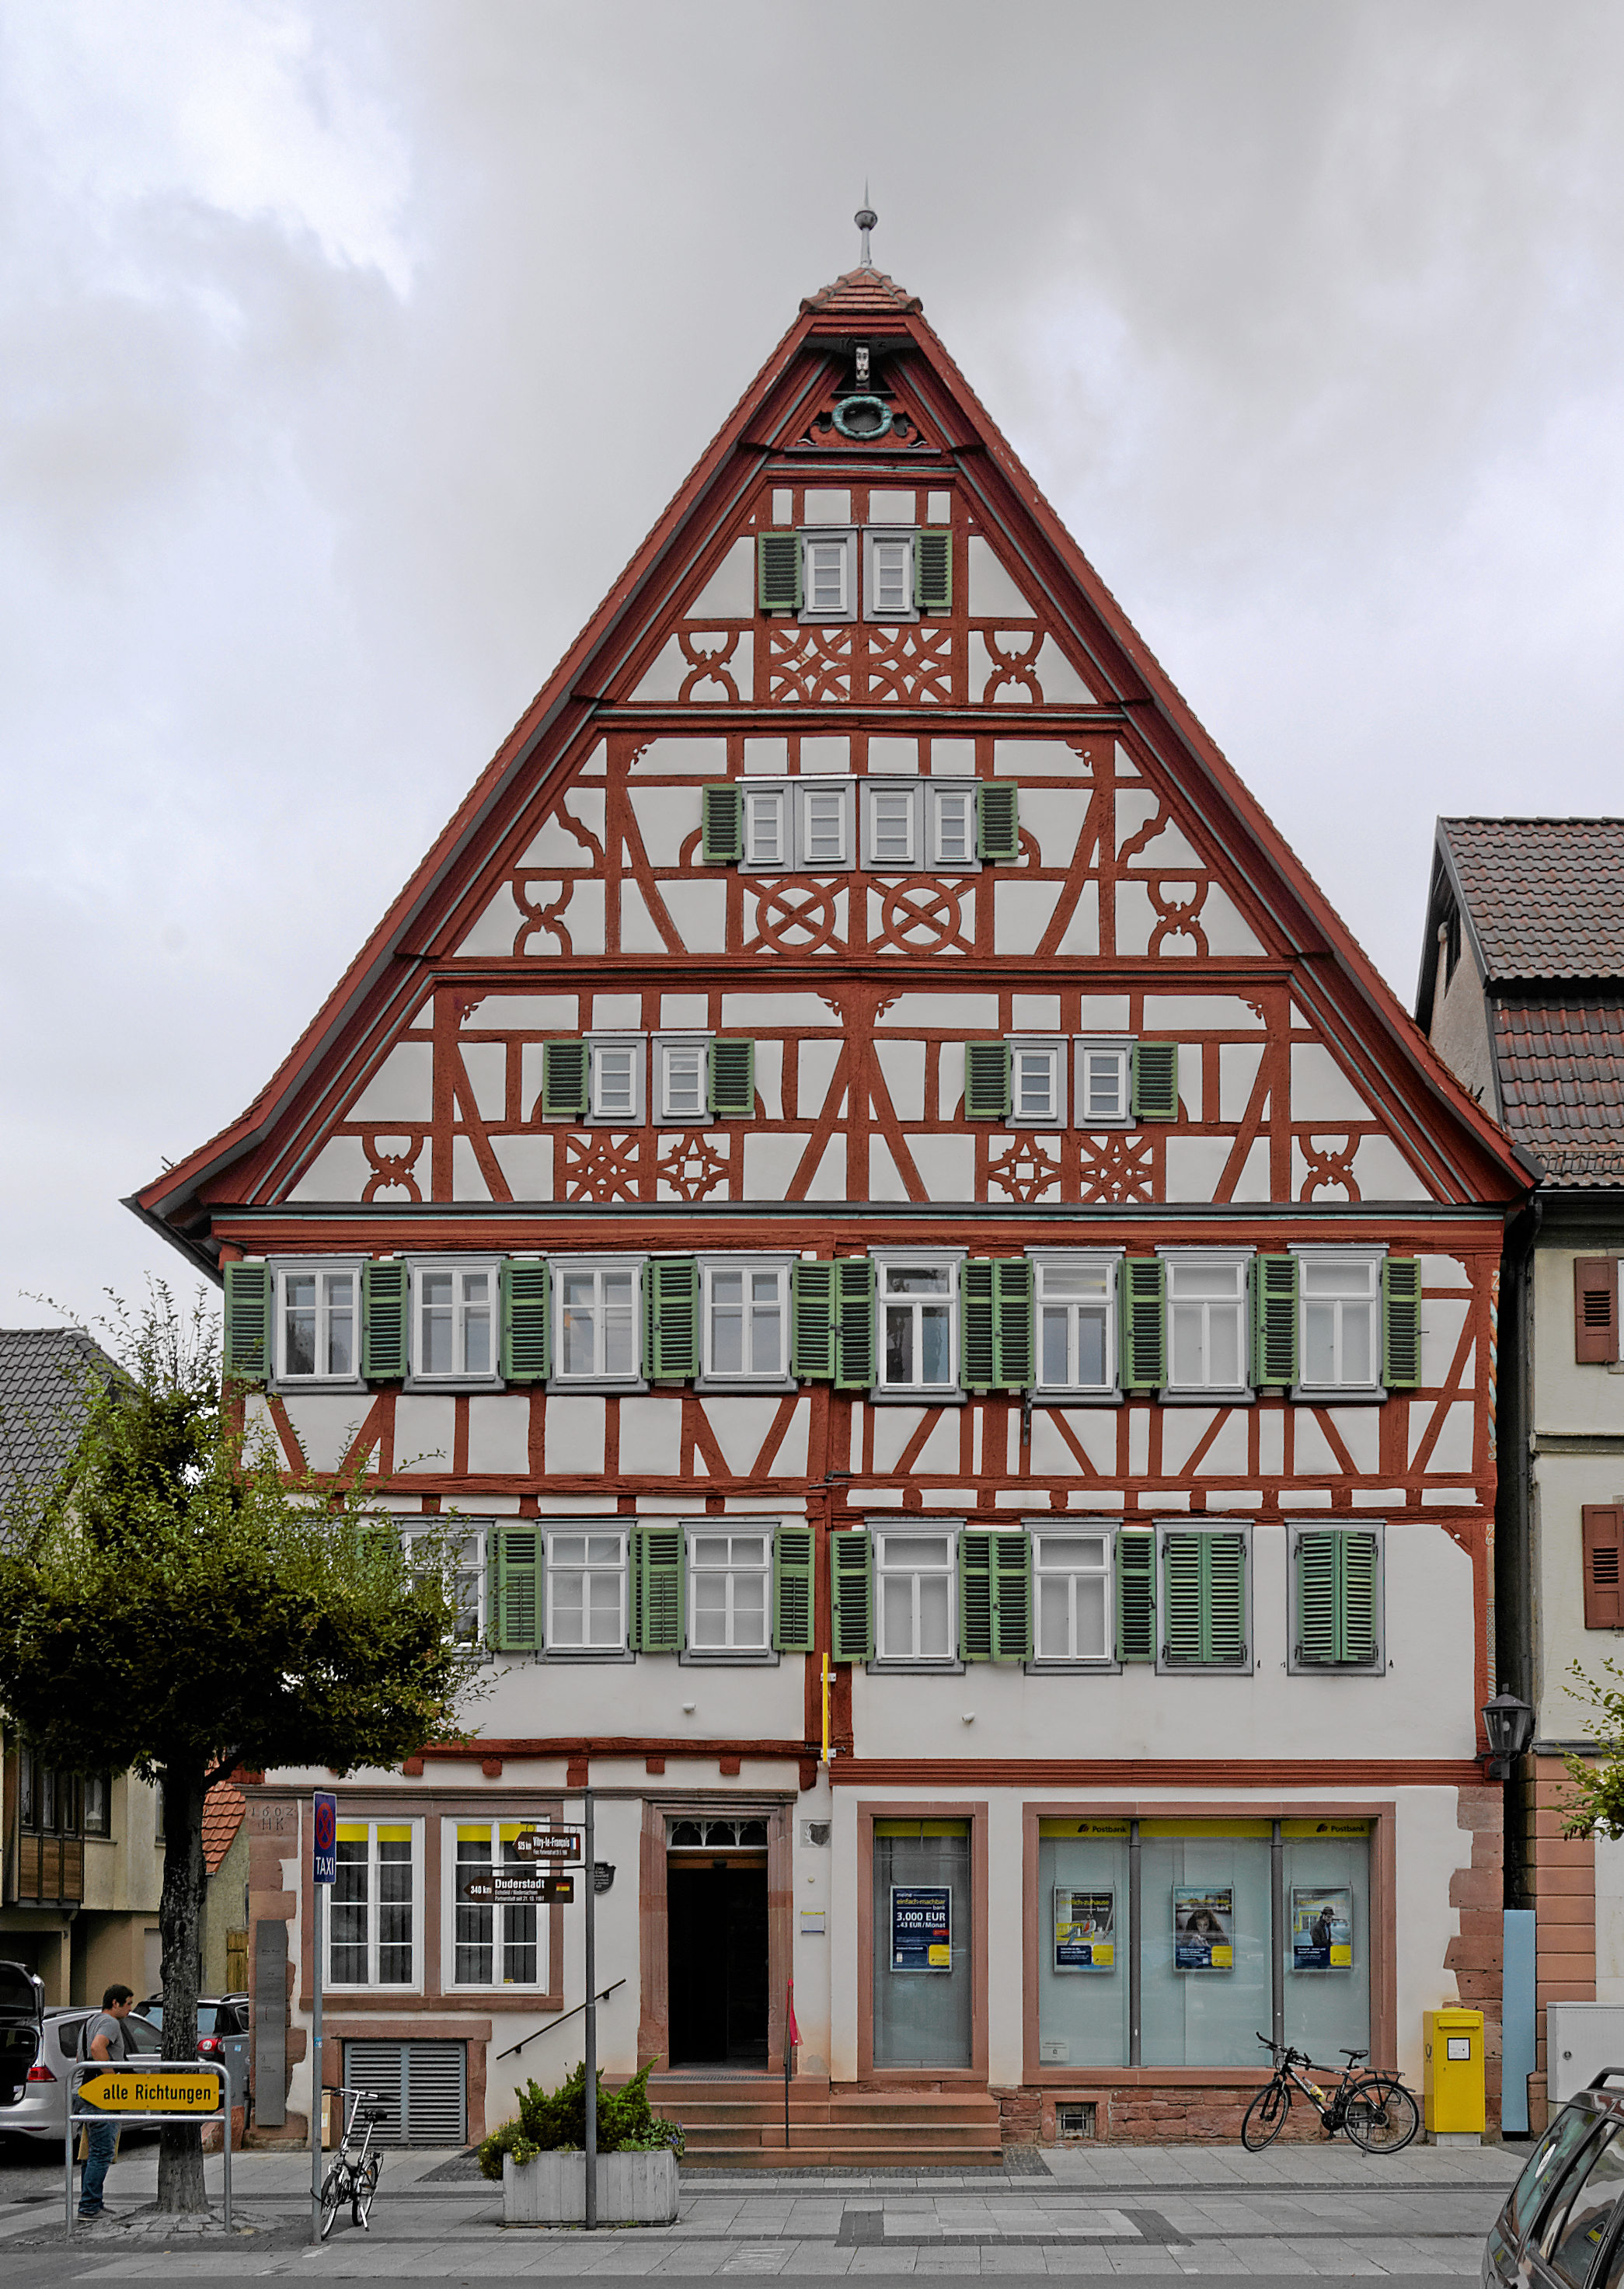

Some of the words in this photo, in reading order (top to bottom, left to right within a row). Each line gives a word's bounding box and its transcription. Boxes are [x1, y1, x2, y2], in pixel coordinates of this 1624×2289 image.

[249, 1806, 294, 1817] 1602
[526, 1841, 532, 1850] km
[315, 1856, 334, 1876] TAXI
[494, 1879, 545, 1889] Duderstadt
[470, 1886, 482, 1894] 340
[483, 1886, 492, 1894] km
[896, 1911, 923, 1921] 3.000
[925, 1911, 946, 1921] EUR
[103, 2084, 128, 2099] alle
[135, 2084, 211, 2104] Richtungen
